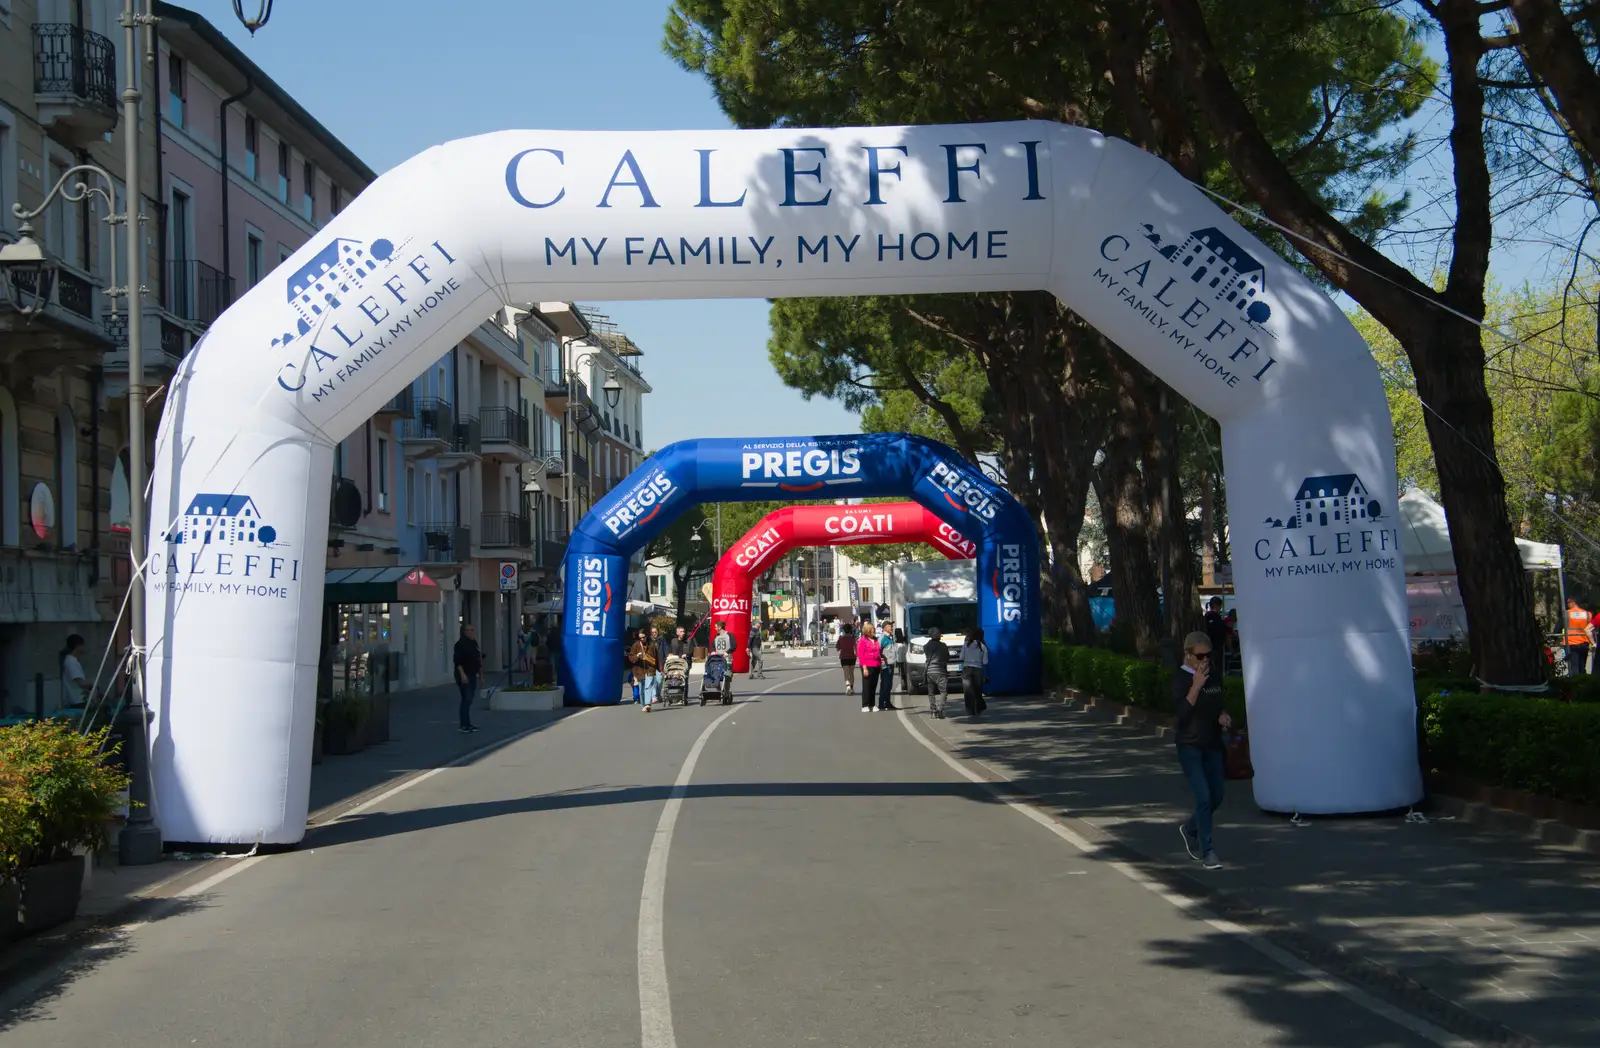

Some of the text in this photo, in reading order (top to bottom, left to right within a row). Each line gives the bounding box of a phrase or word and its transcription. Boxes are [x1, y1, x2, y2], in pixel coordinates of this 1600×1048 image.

[504, 140, 1046, 209] CALEFFI
[544, 230, 1008, 268] MY FAMILY, MY HOME
[277, 240, 457, 392] CALEFFI
[1100, 234, 1278, 382] CALEFFI
[311, 277, 461, 403] MY FAMILY, MY HOME
[1092, 267, 1242, 389] MY FAMILY, MY HOME
[807, 439, 859, 447] RISTORAZIONE
[742, 448, 861, 479] PREGIS
[604, 472, 672, 535] PREGIS
[930, 461, 999, 519] PREGIS
[824, 514, 893, 534] COATI
[736, 527, 780, 567] COATI
[1254, 529, 1399, 561] CALEFFI
[150, 552, 299, 582] CALEFFI
[1003, 544, 1022, 622] PREGIS
[1265, 557, 1396, 578] MY FAMILY, MY HOME
[154, 582, 288, 599] MY FAMILY, MY HOME
[582, 557, 602, 636] PREGIS
[713, 598, 749, 610] COATI
[716, 639, 727, 650] 89
